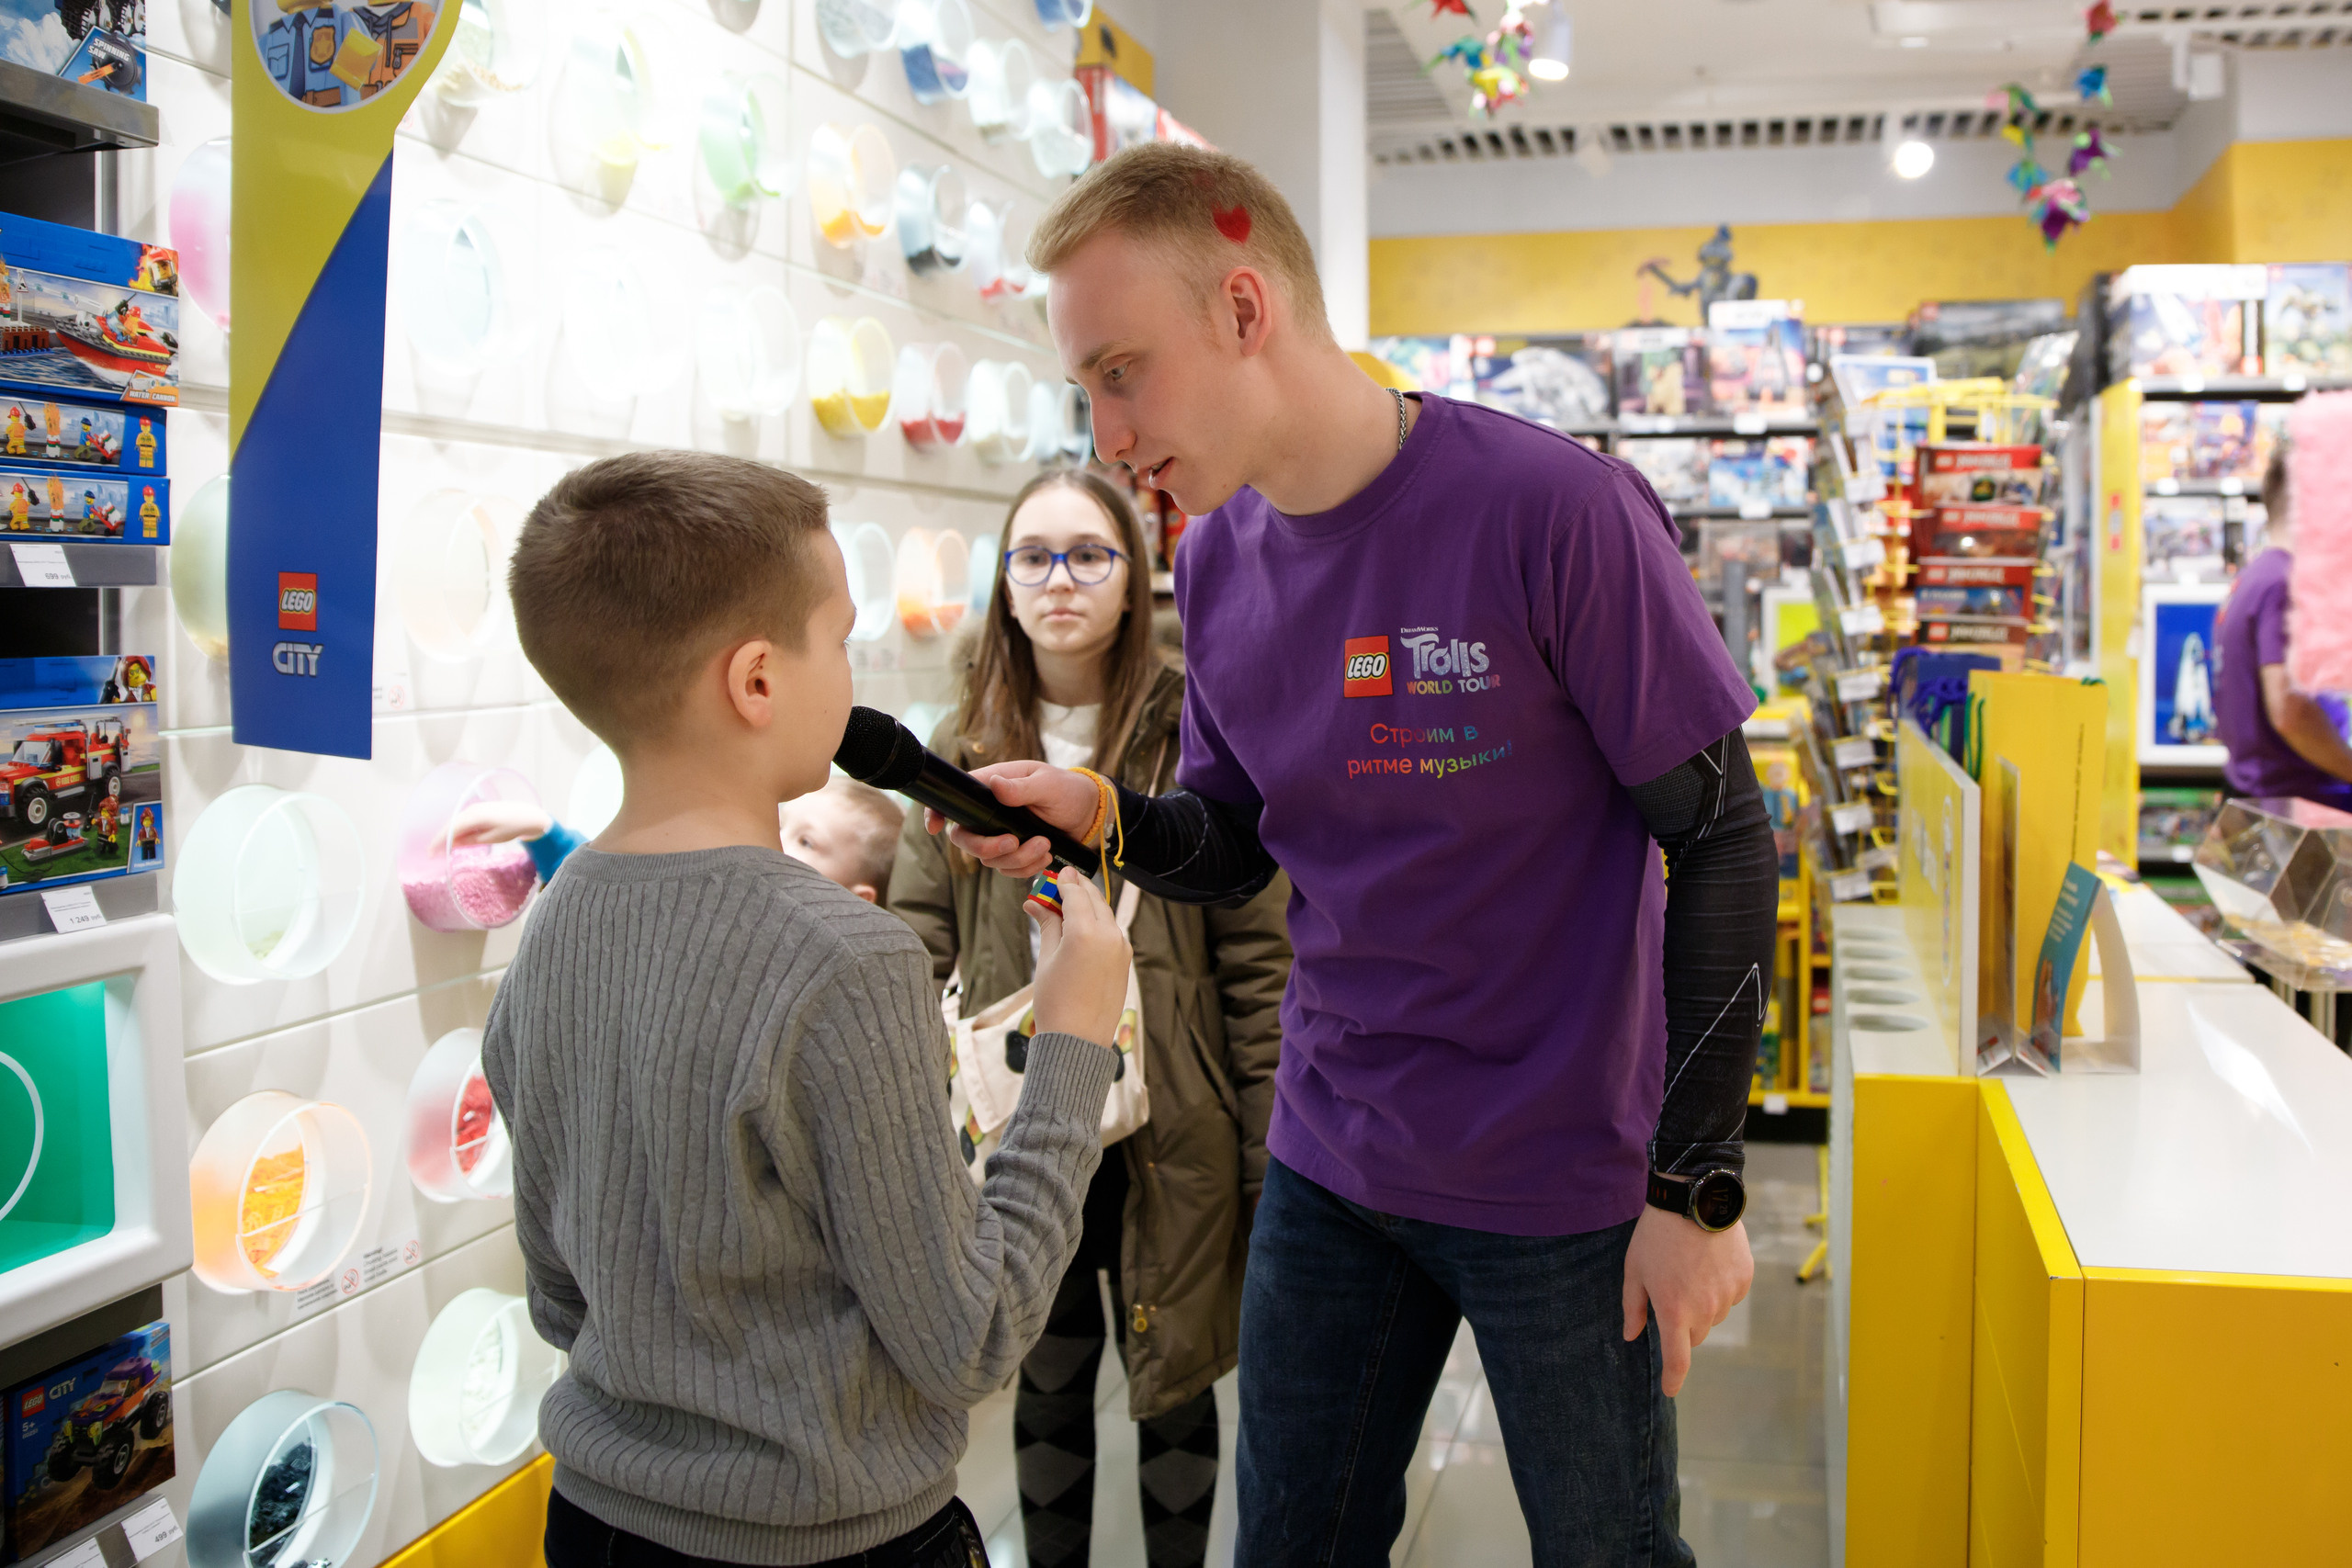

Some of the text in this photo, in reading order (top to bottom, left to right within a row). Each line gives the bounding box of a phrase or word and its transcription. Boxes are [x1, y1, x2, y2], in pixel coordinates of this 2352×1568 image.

[87, 45, 107, 60] SAW
[94, 38, 130, 62] SPINNING
[129, 390, 175, 402] WATER CANNON
[280, 589, 314, 613] LEGO
[272, 642, 323, 677] CITY
[1346, 654, 1387, 680] LEGO
[1400, 633, 1490, 680] Trolls
[1407, 673, 1501, 695] WORLD TOUR
[1370, 723, 1455, 748] Строим
[1347, 739, 1513, 780] ритме музыки!
[24, 1377, 76, 1410] LEGO CITY
[22, 1421, 35, 1432] 5+
[154, 1531, 168, 1543] 499
